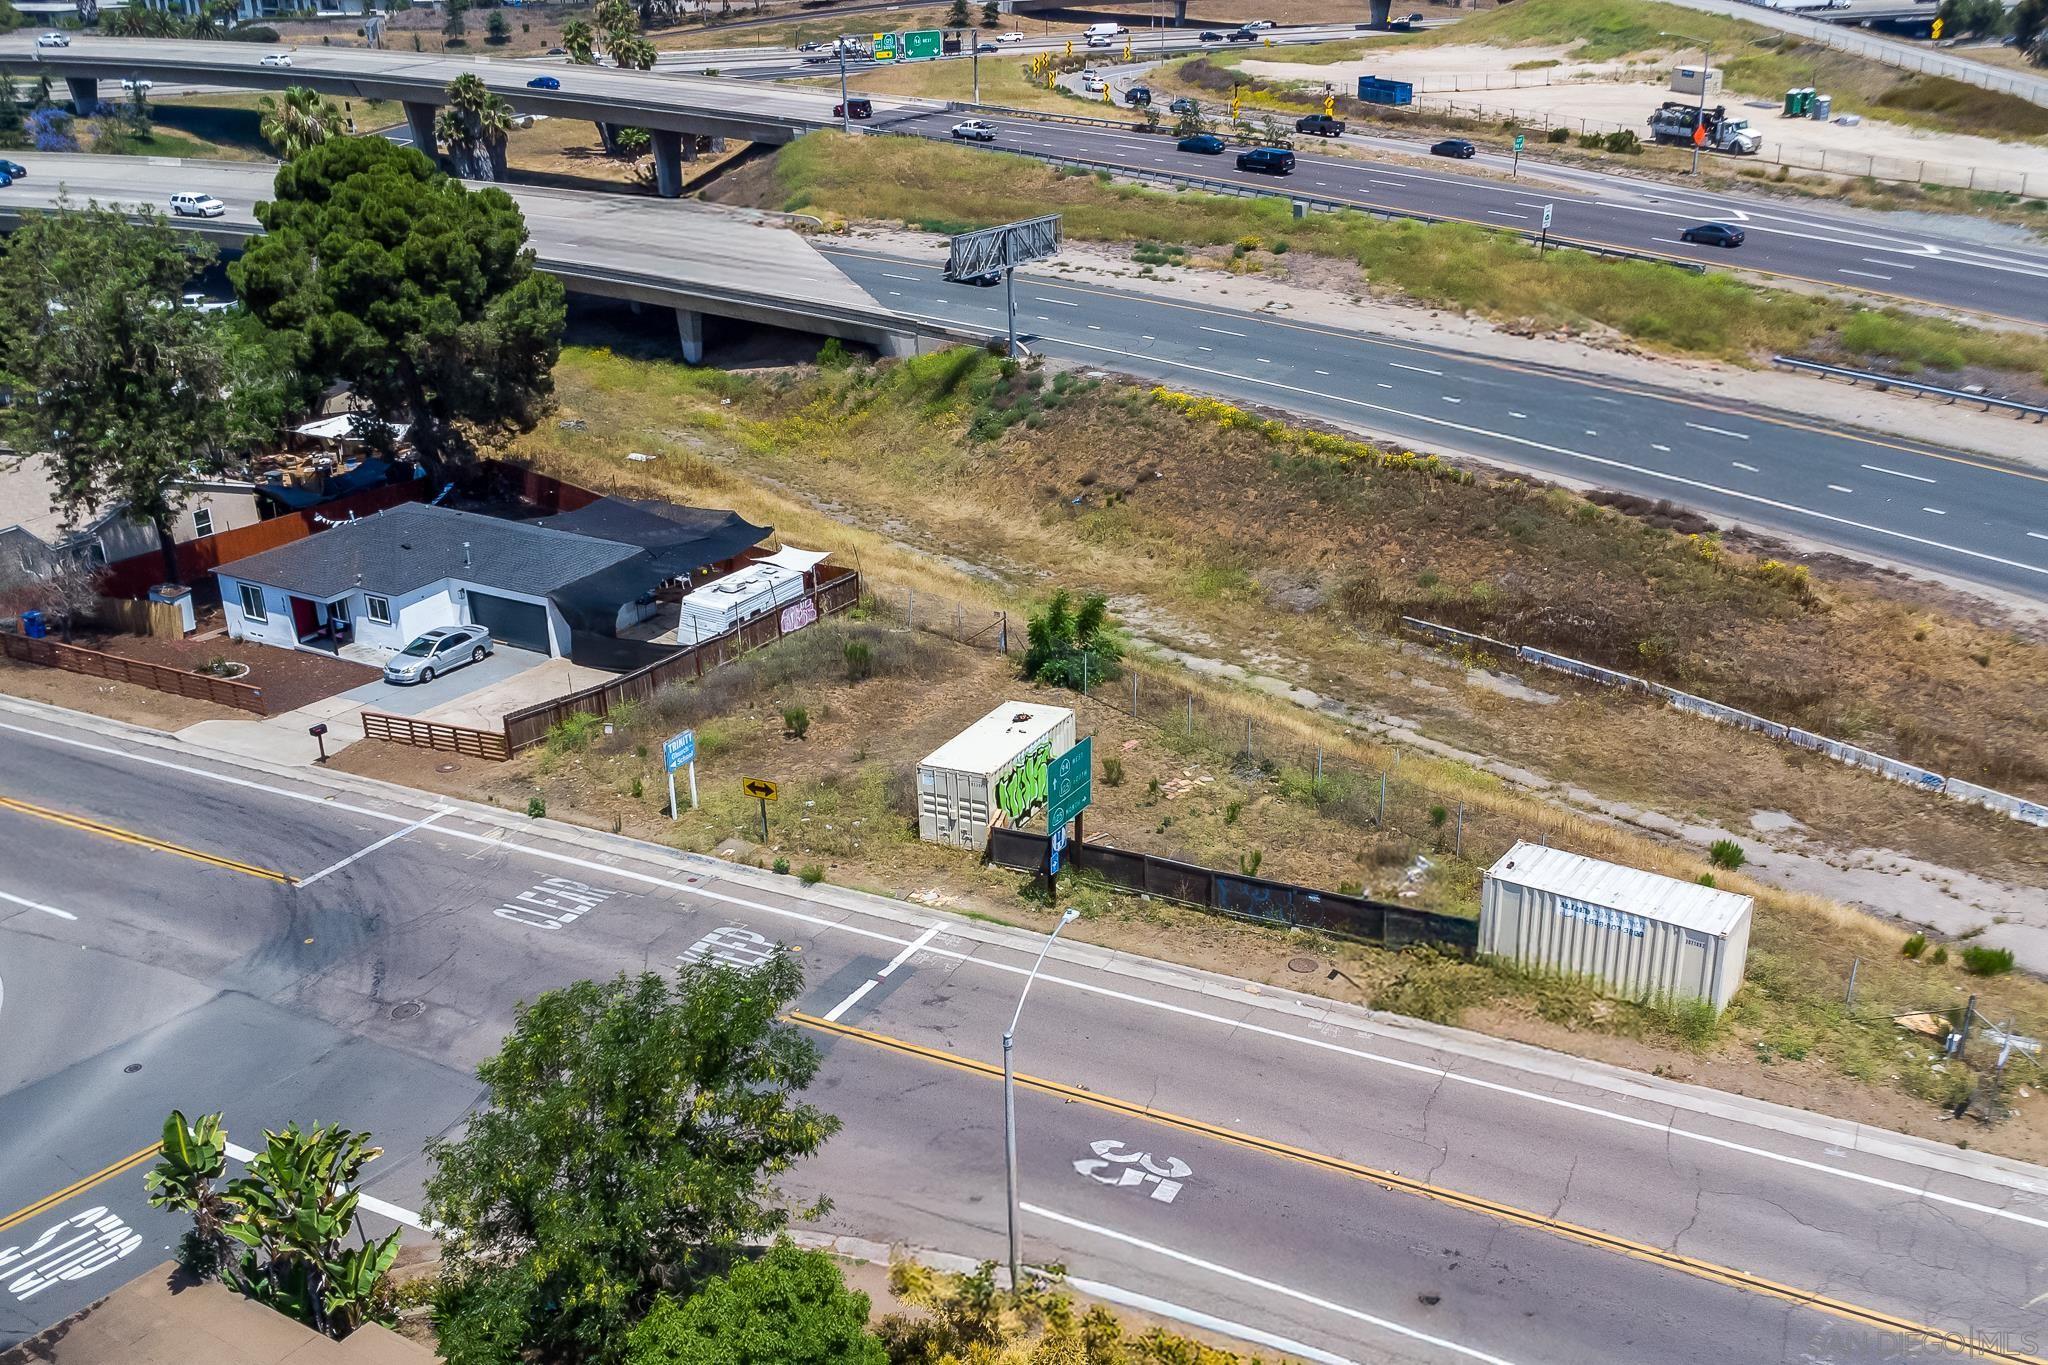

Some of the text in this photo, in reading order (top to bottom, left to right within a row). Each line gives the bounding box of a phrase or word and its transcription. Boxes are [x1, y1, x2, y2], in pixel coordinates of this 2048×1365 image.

[668, 733, 691, 753] TRINITY
[671, 746, 690, 760] Church
[677, 750, 694, 765] School
[1072, 752, 1083, 764] WEST
[1073, 769, 1088, 784] SOUTH
[1065, 801, 1080, 816] NORTH
[493, 877, 618, 930] CLEAR
[1072, 1139, 1193, 1204] 35
[0, 1206, 143, 1301] STOP
